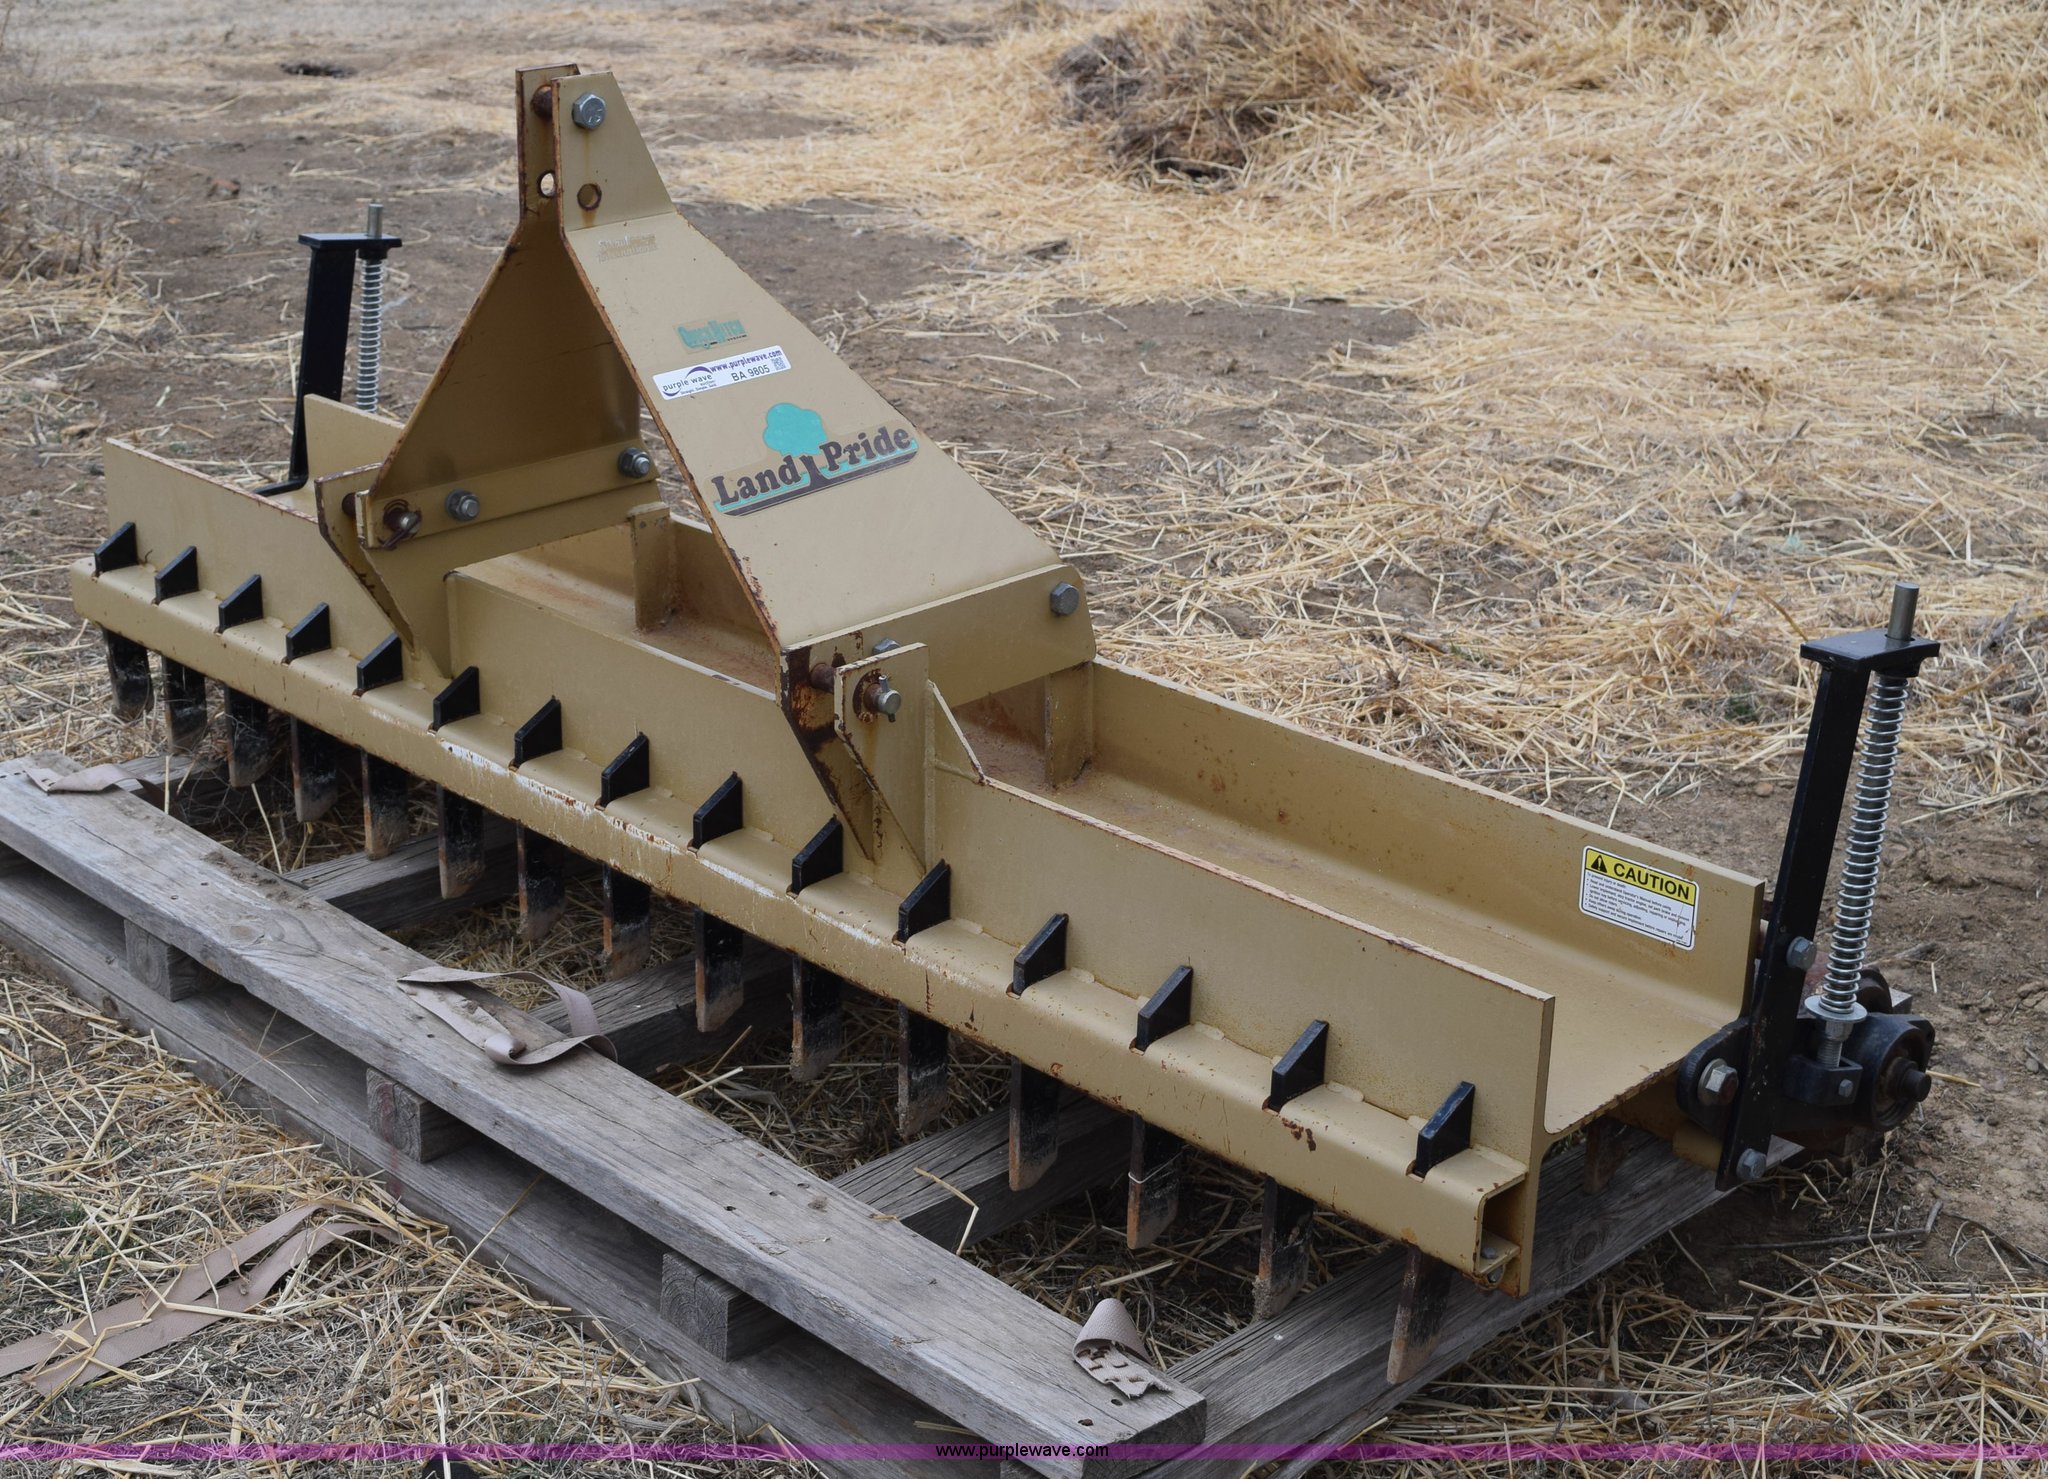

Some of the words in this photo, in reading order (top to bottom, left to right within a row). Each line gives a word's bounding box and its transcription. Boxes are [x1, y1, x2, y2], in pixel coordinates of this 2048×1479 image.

[709, 349, 782, 372] www.purplewave.com
[663, 380, 689, 391] purple
[691, 374, 713, 385] wave
[731, 371, 747, 381] BA
[747, 364, 770, 377] 9805
[711, 455, 801, 506] Land
[819, 426, 911, 471] Pride
[1613, 863, 1689, 900] CAUTION
